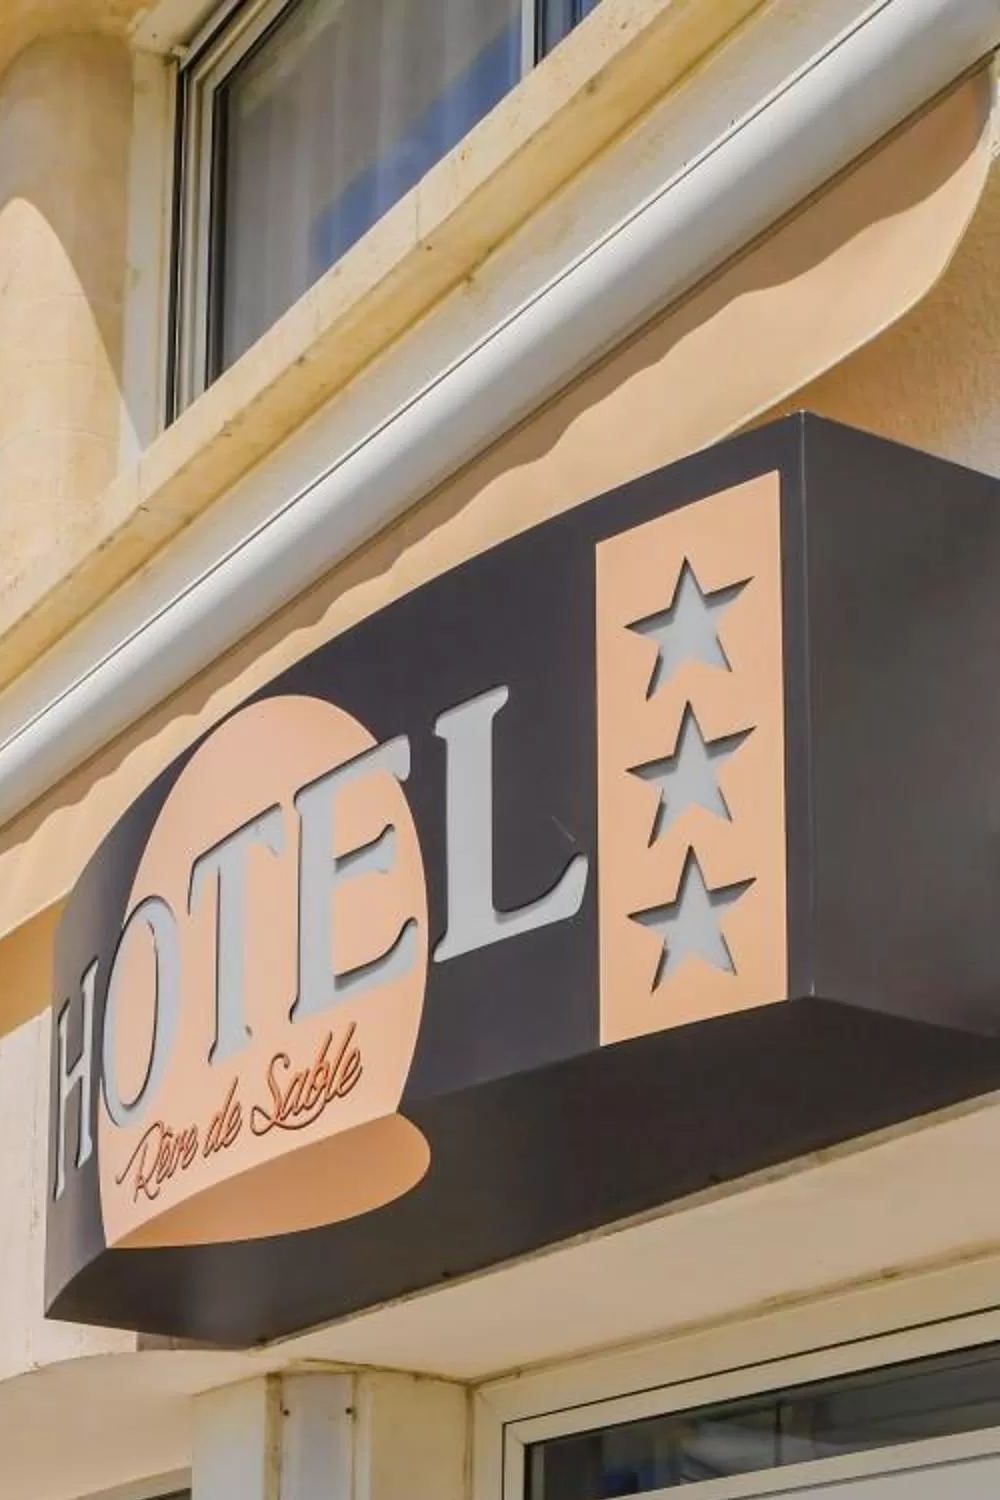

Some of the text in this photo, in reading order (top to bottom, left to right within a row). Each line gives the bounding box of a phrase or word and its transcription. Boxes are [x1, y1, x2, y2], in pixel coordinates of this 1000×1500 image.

[53, 684, 590, 1202] HOTEL
[115, 1021, 363, 1203] Rêve de Sable
